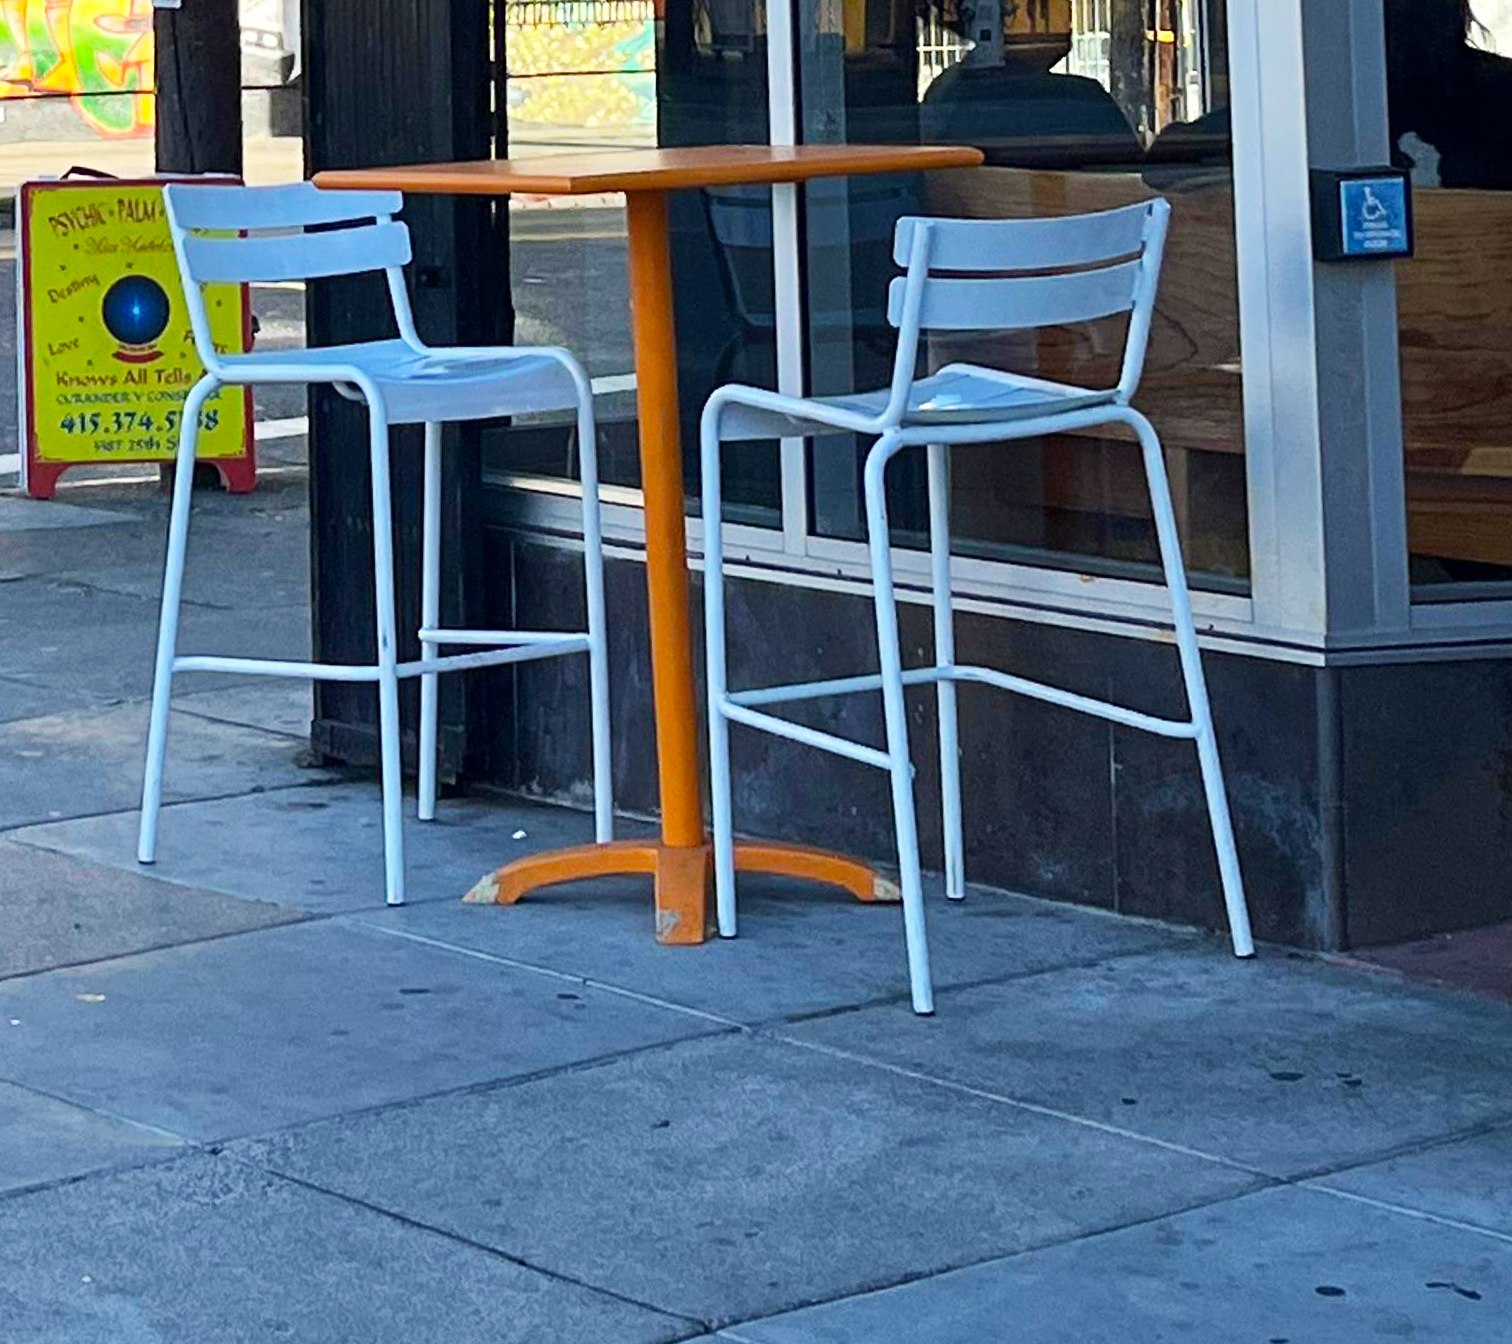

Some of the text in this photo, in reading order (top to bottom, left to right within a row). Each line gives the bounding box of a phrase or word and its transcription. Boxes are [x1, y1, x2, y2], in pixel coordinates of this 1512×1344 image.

[117, 198, 159, 223] PALM
[48, 338, 79, 356] Love
[56, 371, 117, 387] Knows
[122, 368, 147, 384] All
[154, 368, 191, 384] Tells
[59, 409, 220, 434] 415.374.58
